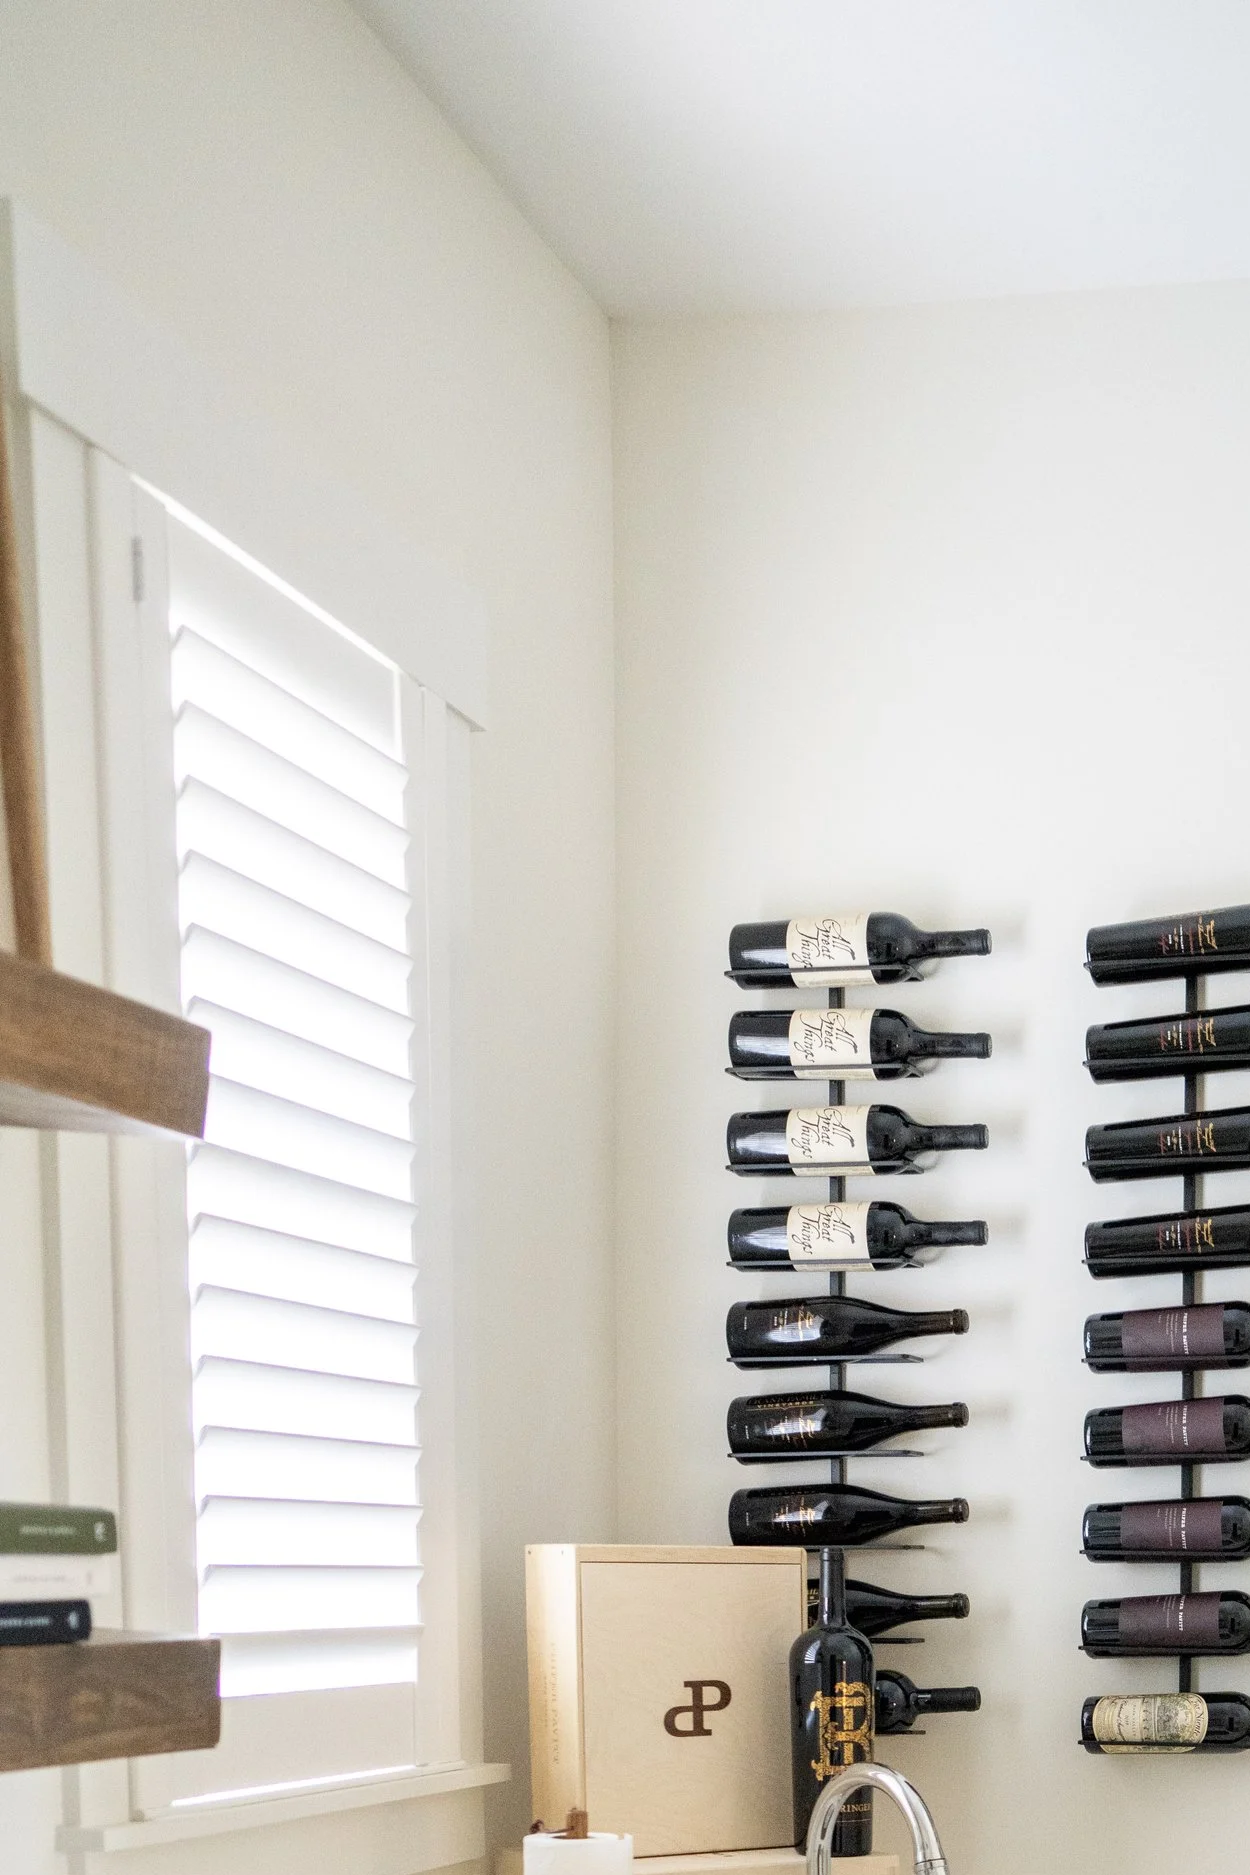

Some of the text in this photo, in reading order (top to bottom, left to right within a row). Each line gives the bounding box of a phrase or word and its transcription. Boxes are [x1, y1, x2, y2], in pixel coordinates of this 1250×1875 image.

[832, 921, 856, 960] All
[794, 1013, 823, 1063] Things
[835, 1013, 858, 1054] All
[791, 1110, 820, 1158] Things
[833, 1111, 855, 1148] All
[791, 1208, 820, 1254] Things
[833, 1208, 855, 1244] All
[1193, 1709, 1204, 1737] Niente
